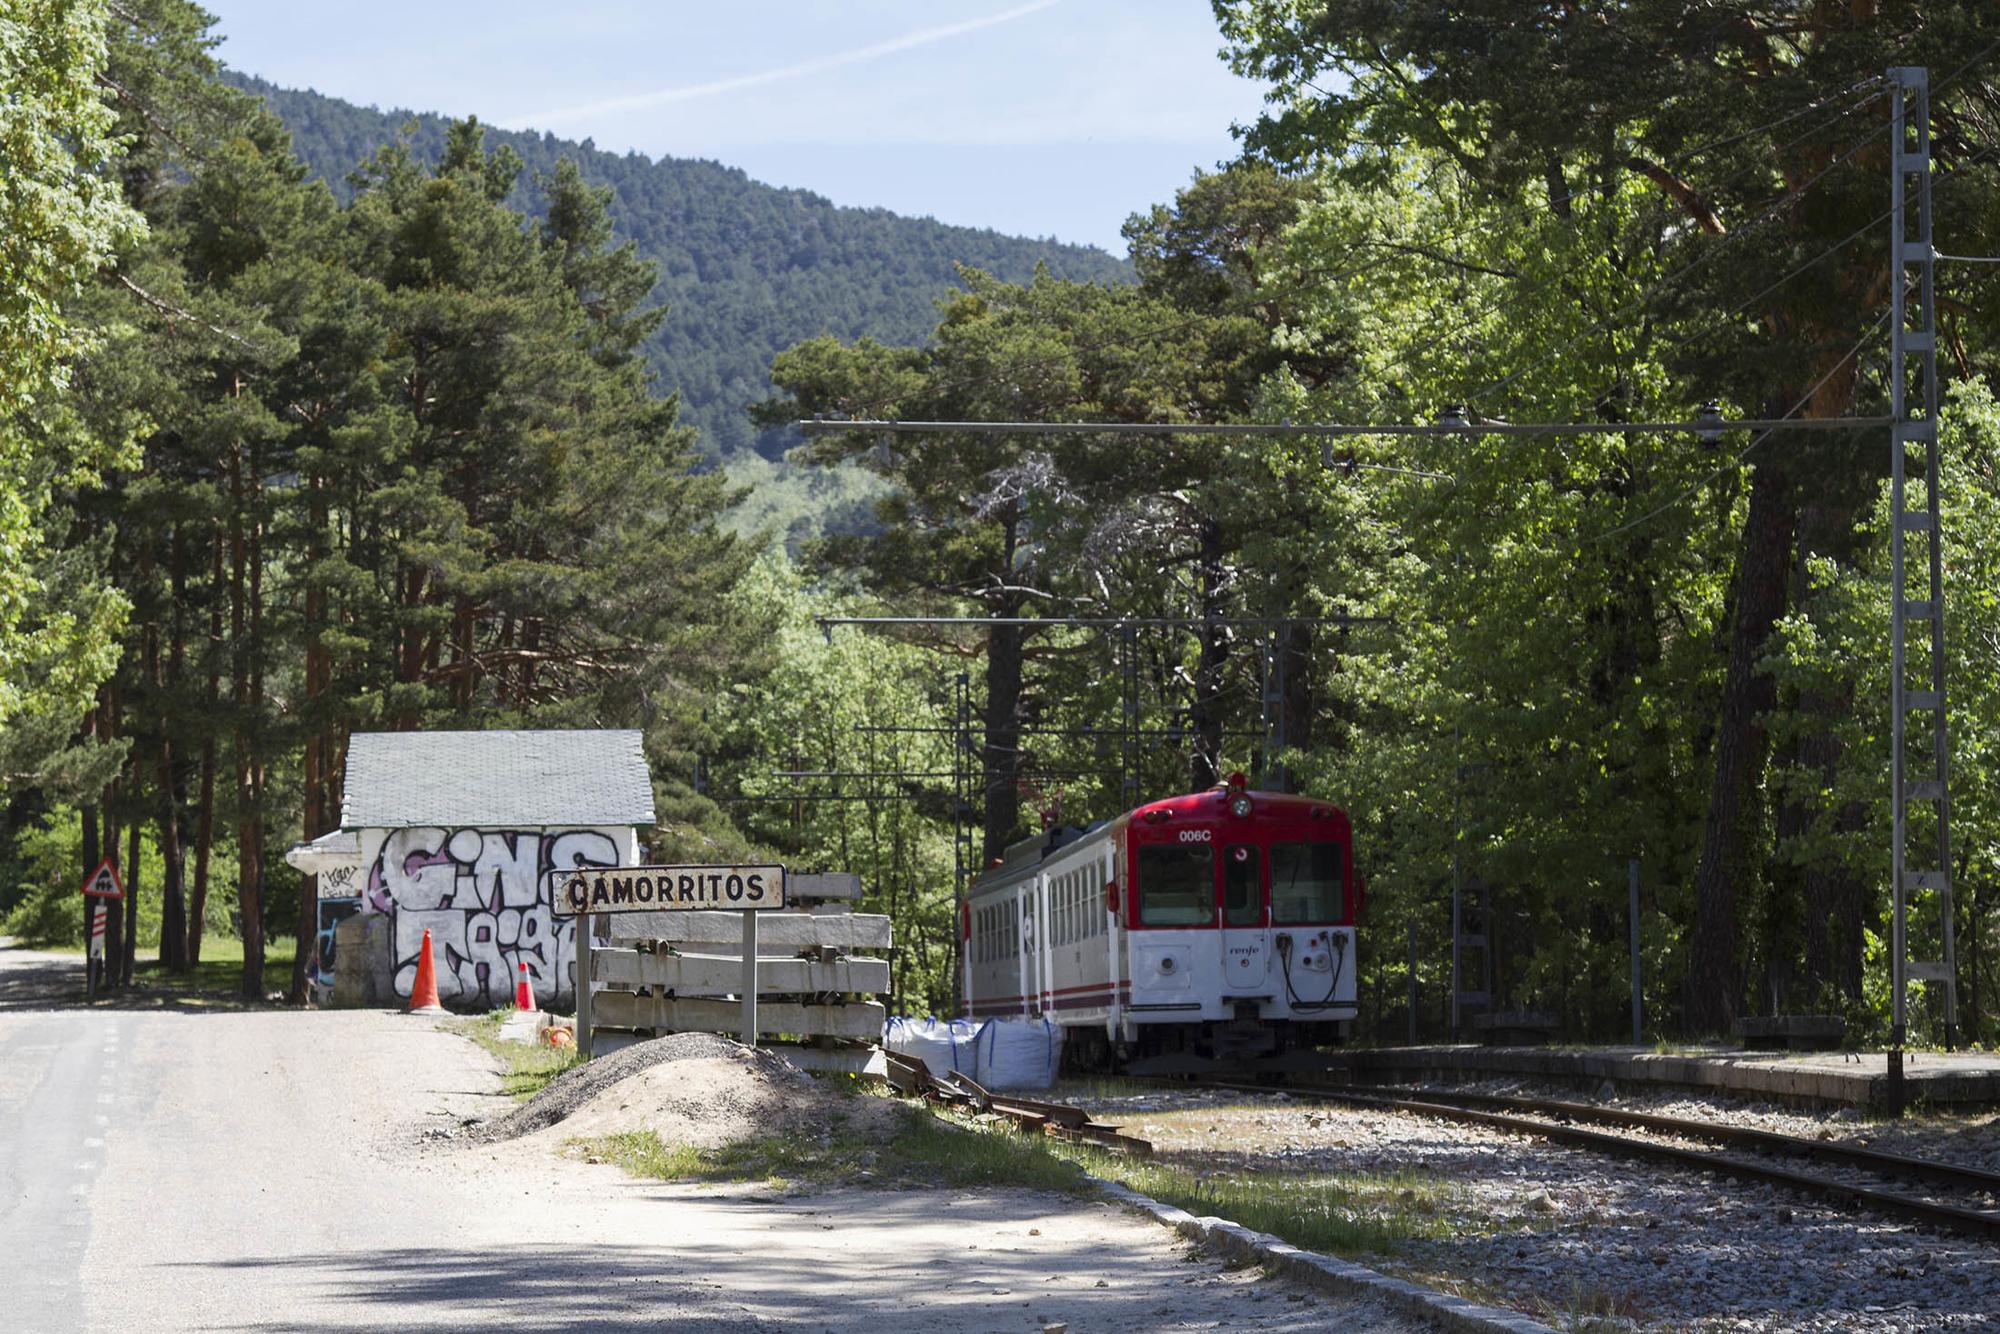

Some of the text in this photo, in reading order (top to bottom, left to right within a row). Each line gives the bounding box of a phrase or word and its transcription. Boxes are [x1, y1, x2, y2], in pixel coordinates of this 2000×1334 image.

[1179, 830, 1212, 842] 006C
[569, 873, 765, 906] CAMORRITOS
[1230, 945, 1260, 957] renfe
